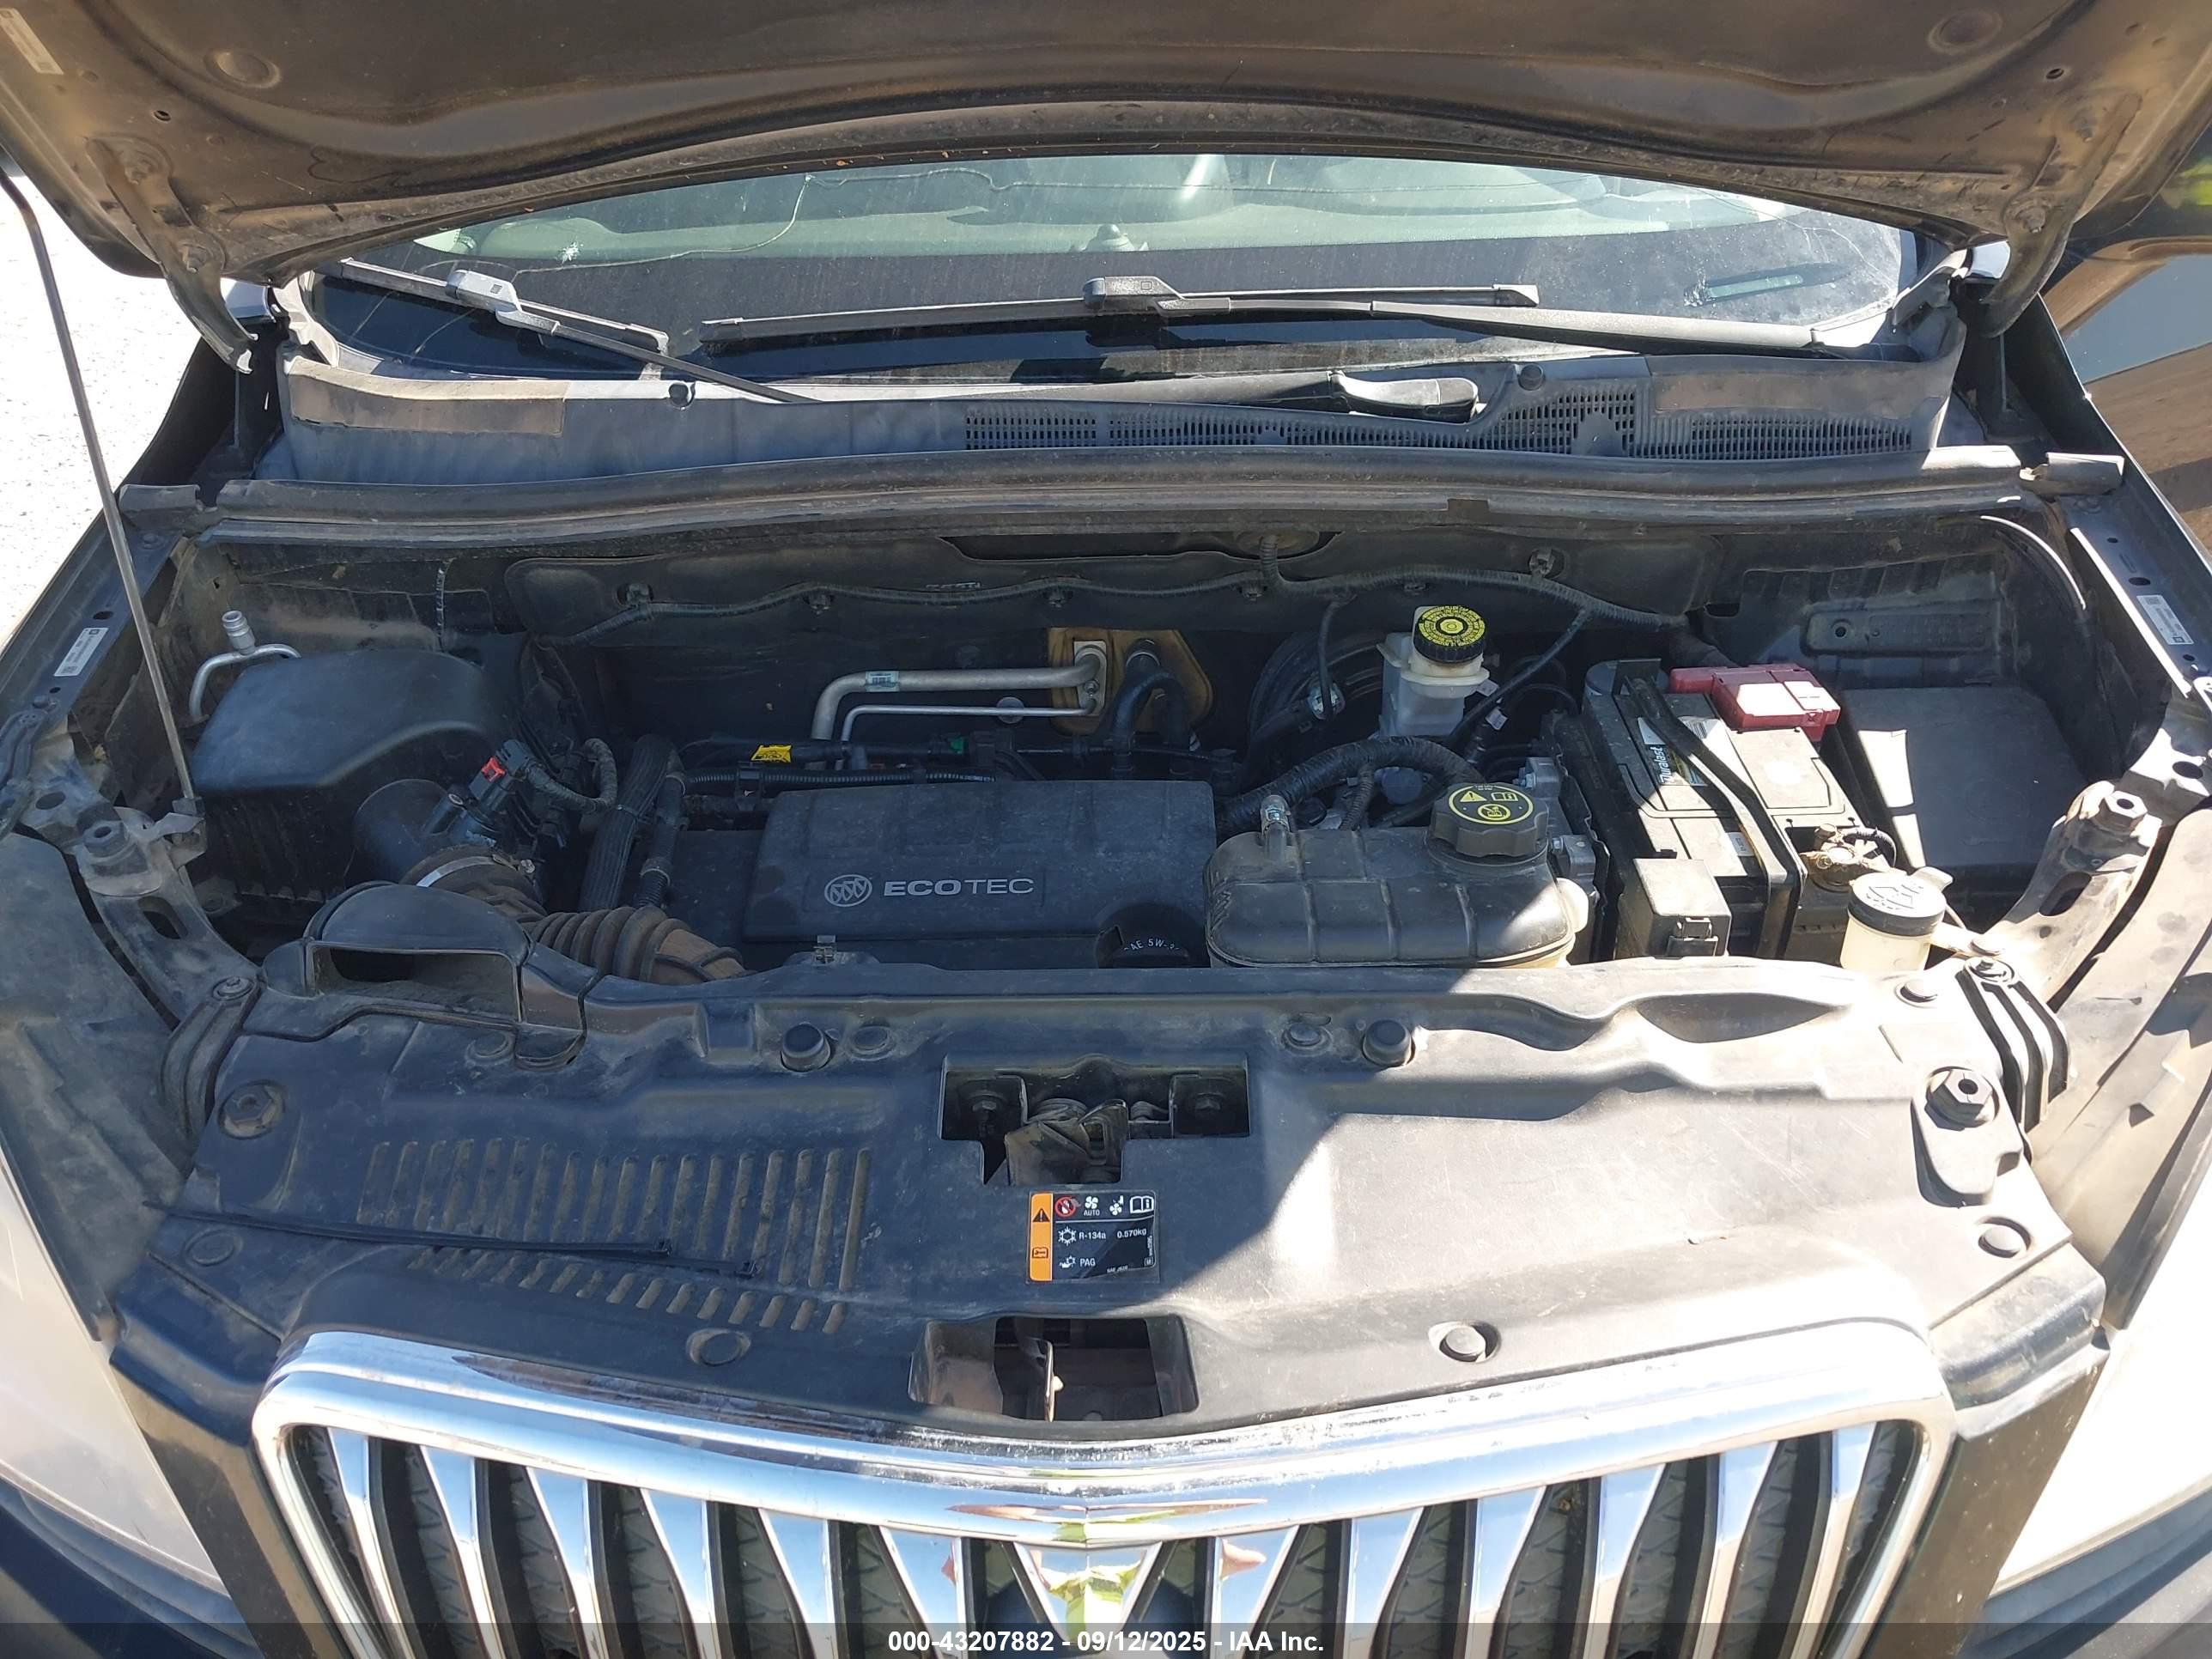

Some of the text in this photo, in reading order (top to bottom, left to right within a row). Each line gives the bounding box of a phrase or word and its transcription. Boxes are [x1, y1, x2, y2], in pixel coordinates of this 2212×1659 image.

[884, 878, 1034, 896] ECOTEC
[1079, 1231, 1106, 1240] R-134a
[1079, 1258, 1096, 1267] PAG
